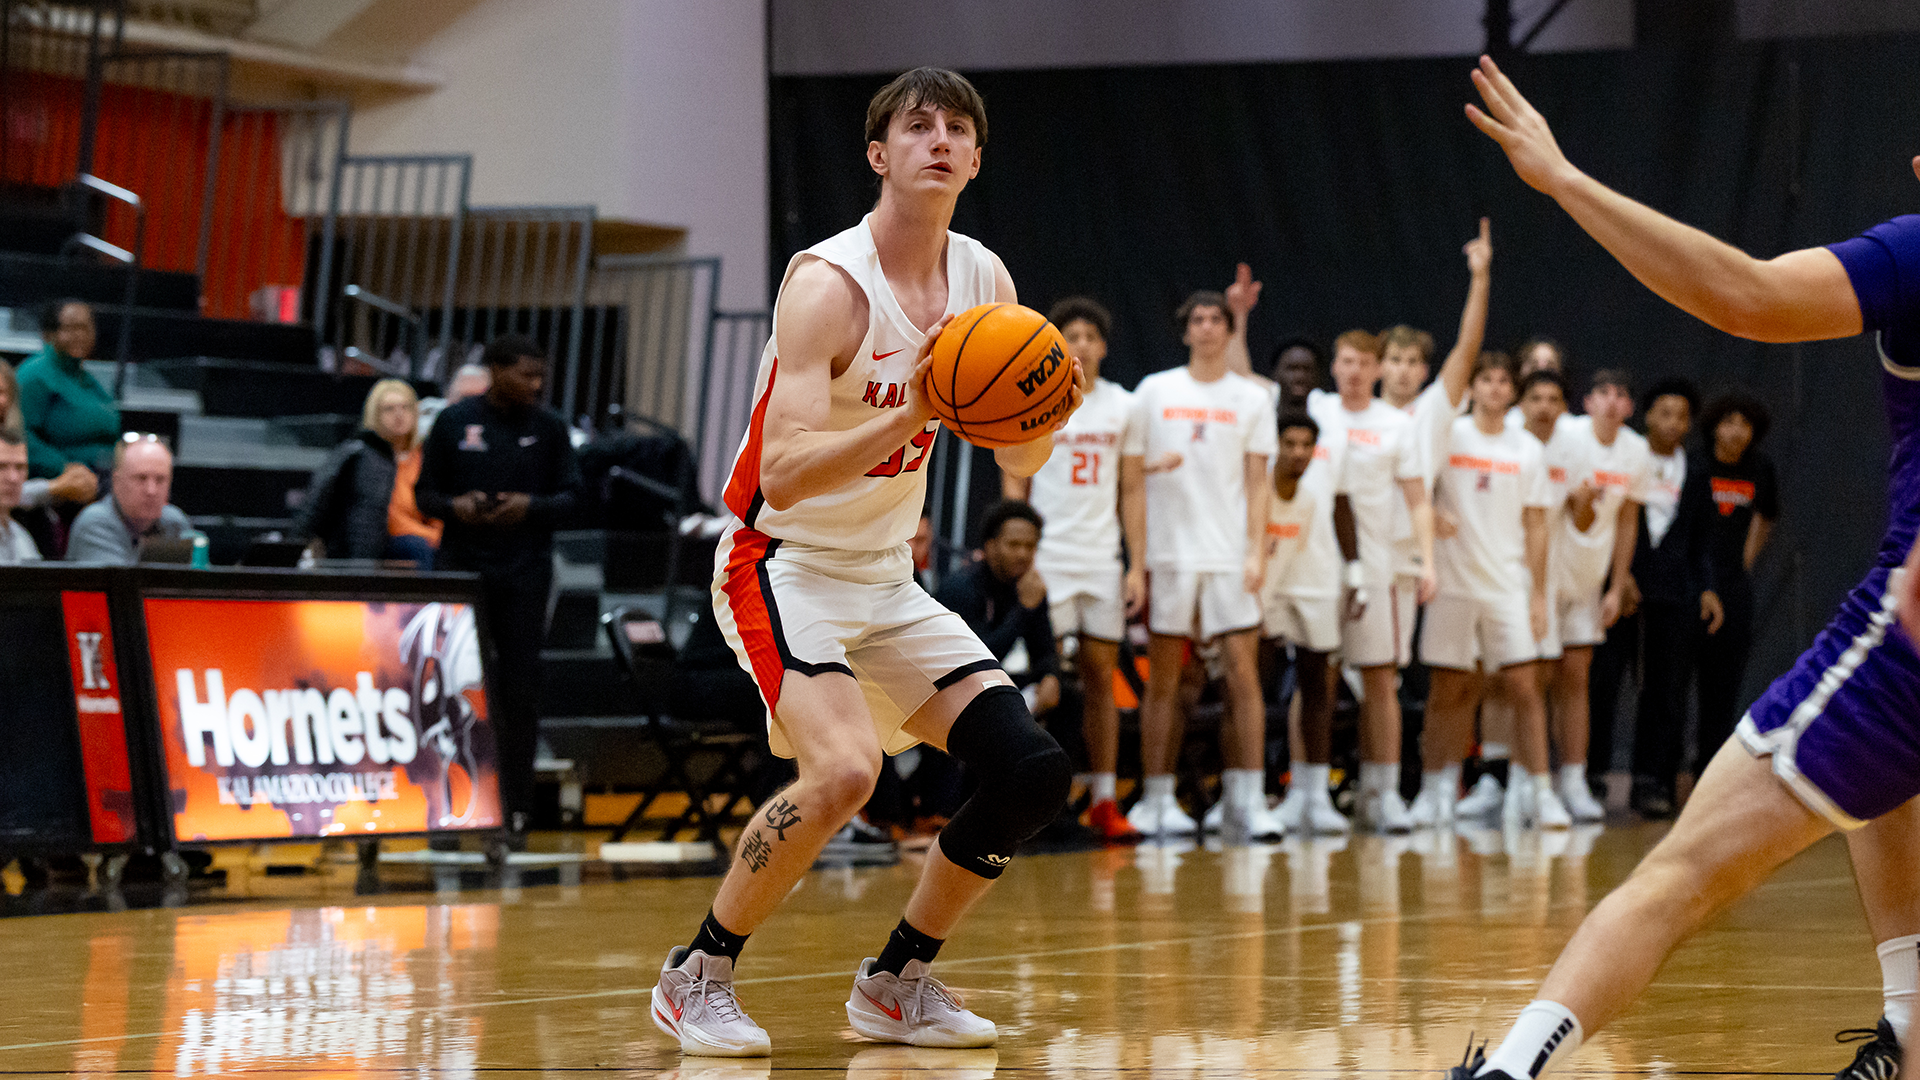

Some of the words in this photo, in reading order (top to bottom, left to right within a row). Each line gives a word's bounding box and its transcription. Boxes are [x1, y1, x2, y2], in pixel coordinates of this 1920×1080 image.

[1016, 340, 1065, 398] NCAA
[1071, 451, 1101, 486] 21
[175, 668, 418, 768] Hornets
